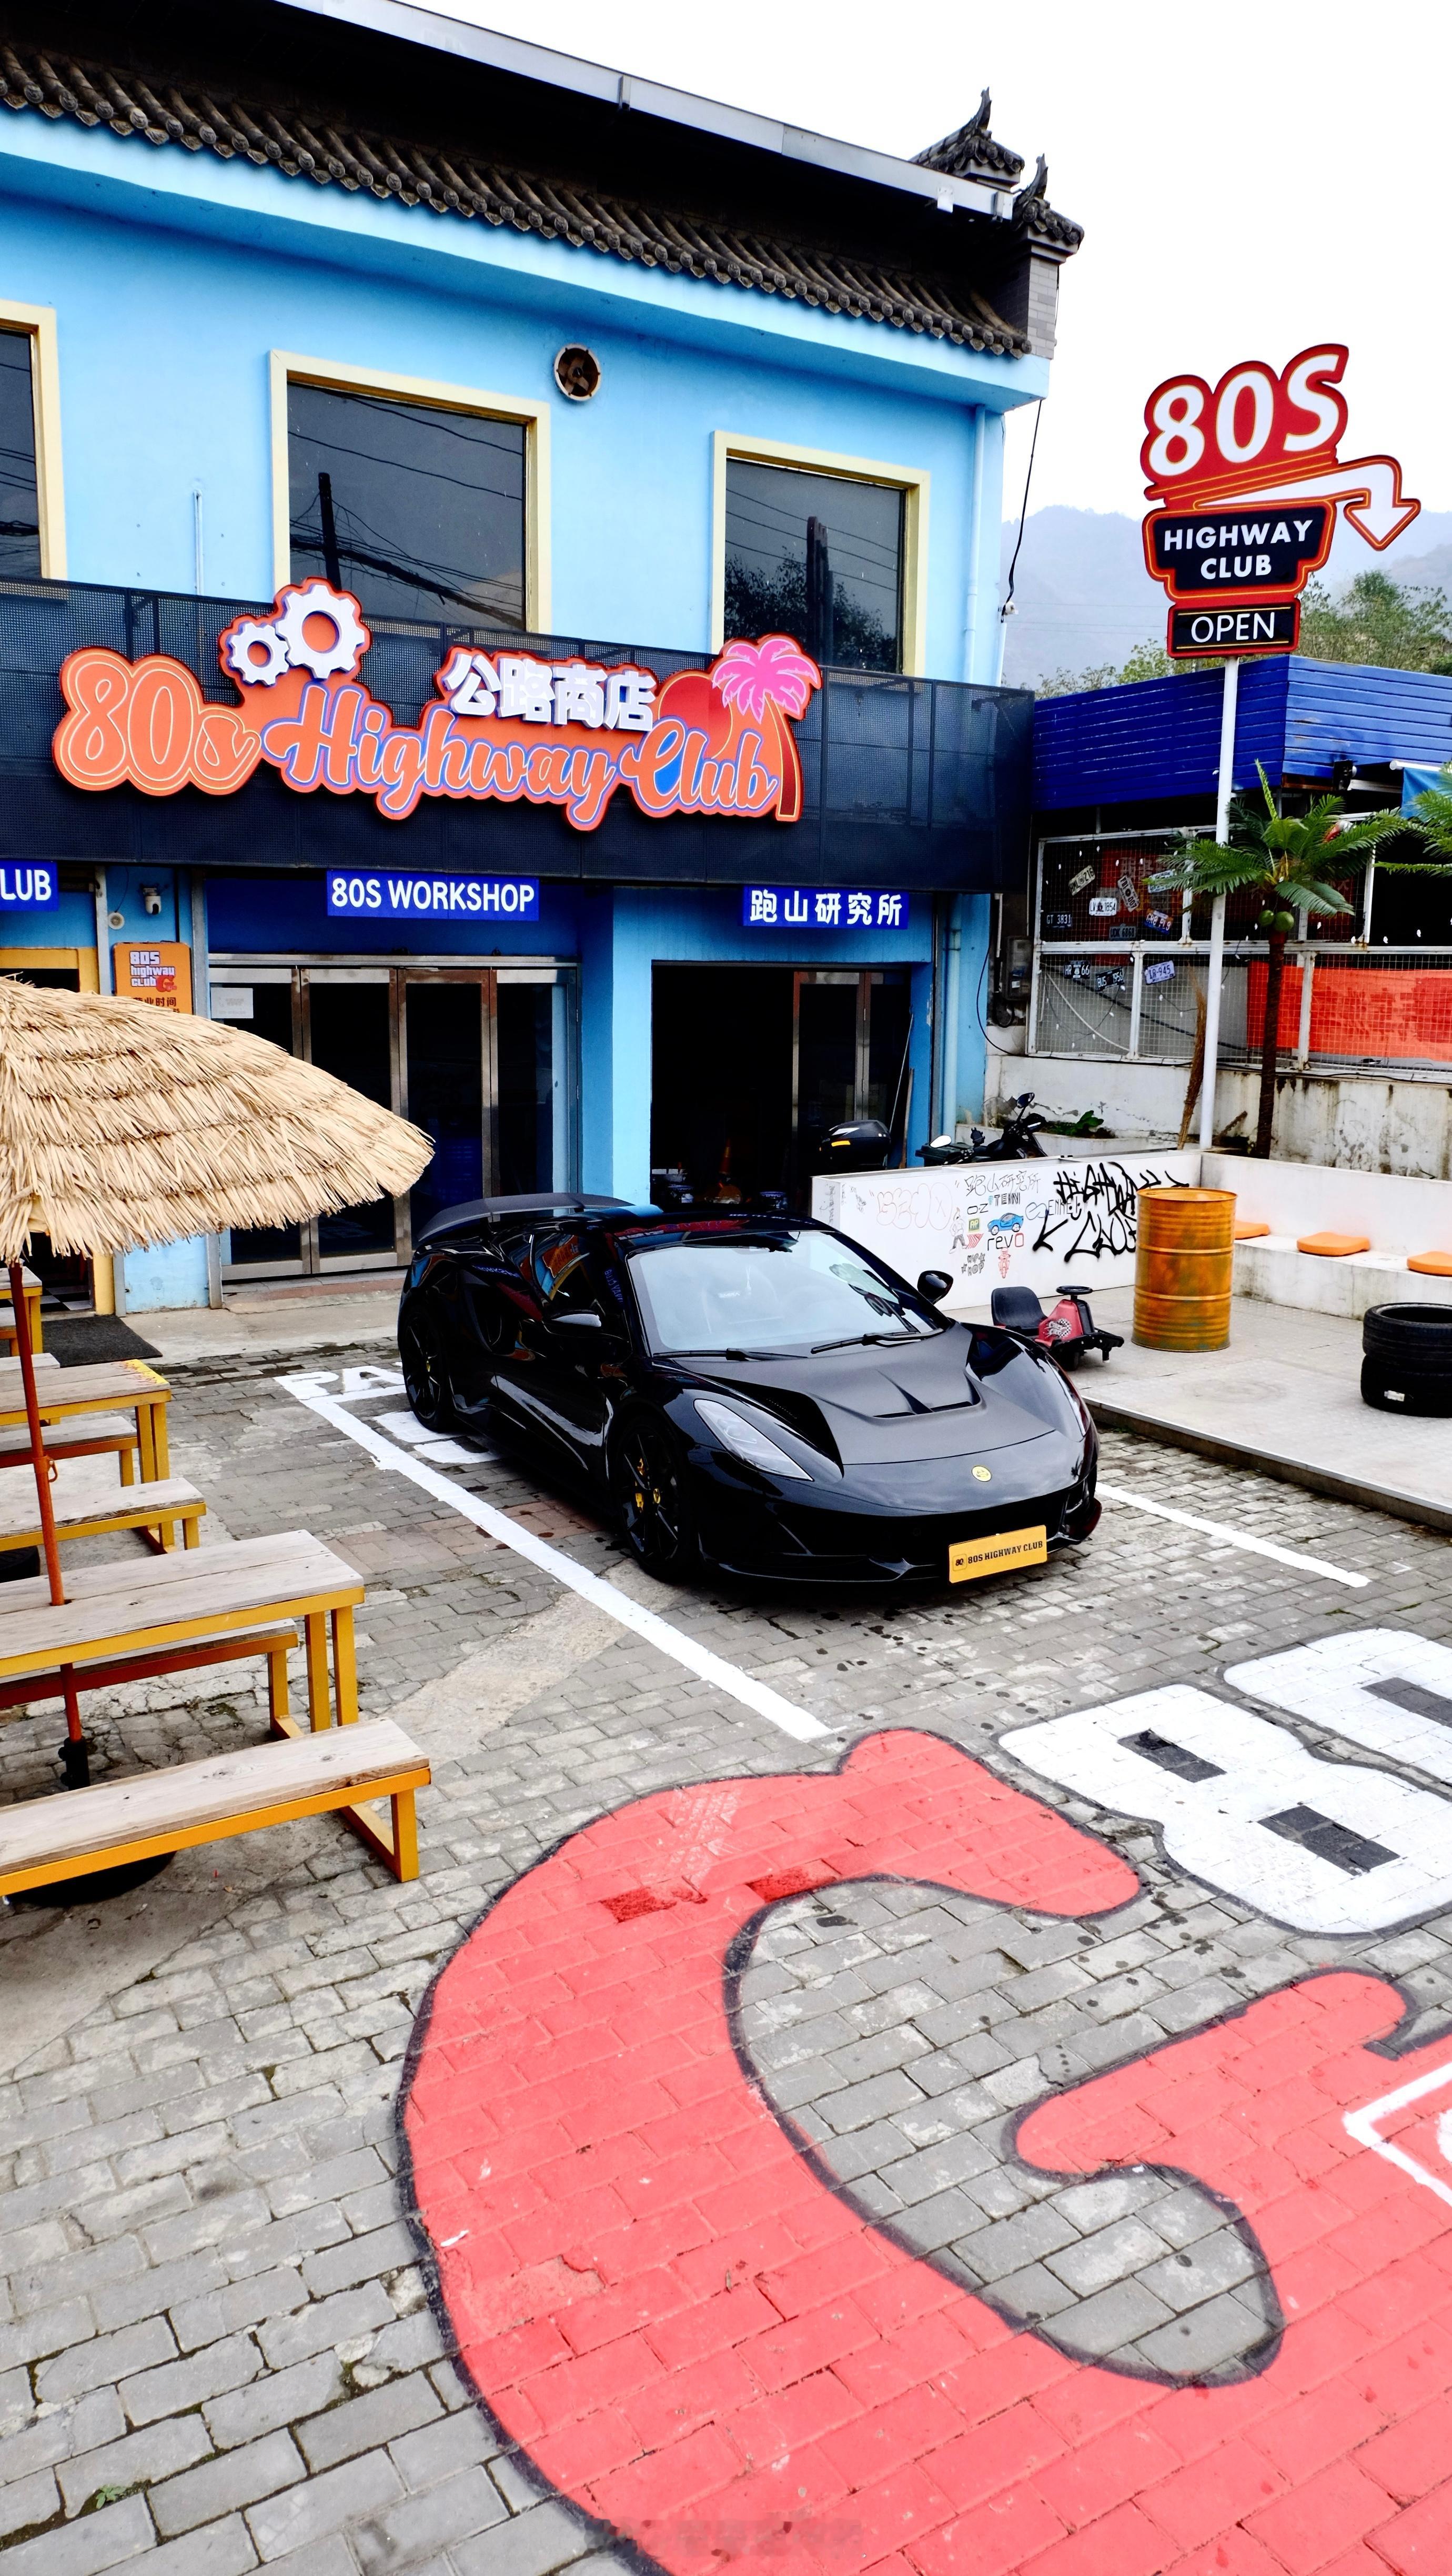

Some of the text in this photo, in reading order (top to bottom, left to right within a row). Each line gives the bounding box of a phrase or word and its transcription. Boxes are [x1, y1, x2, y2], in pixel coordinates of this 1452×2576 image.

[1149, 354, 1339, 476] 80S
[1163, 519, 1313, 551] HIGHWAY
[1200, 555, 1272, 579] CLUB
[1191, 611, 1275, 643] OPEN
[443, 653, 658, 732] 公路商店
[61, 654, 779, 827] 80s Highway Club
[331, 878, 535, 912] 80S WORKSHOP
[750, 889, 903, 926] 跑山研究所
[1081, 964, 1090, 975] 66
[964, 1171, 1041, 1196] 跑山研究所
[967, 1554, 983, 1564] 80S
[984, 1545, 1022, 1561] HIGHWAY
[1023, 1541, 1043, 1552] CLUB
